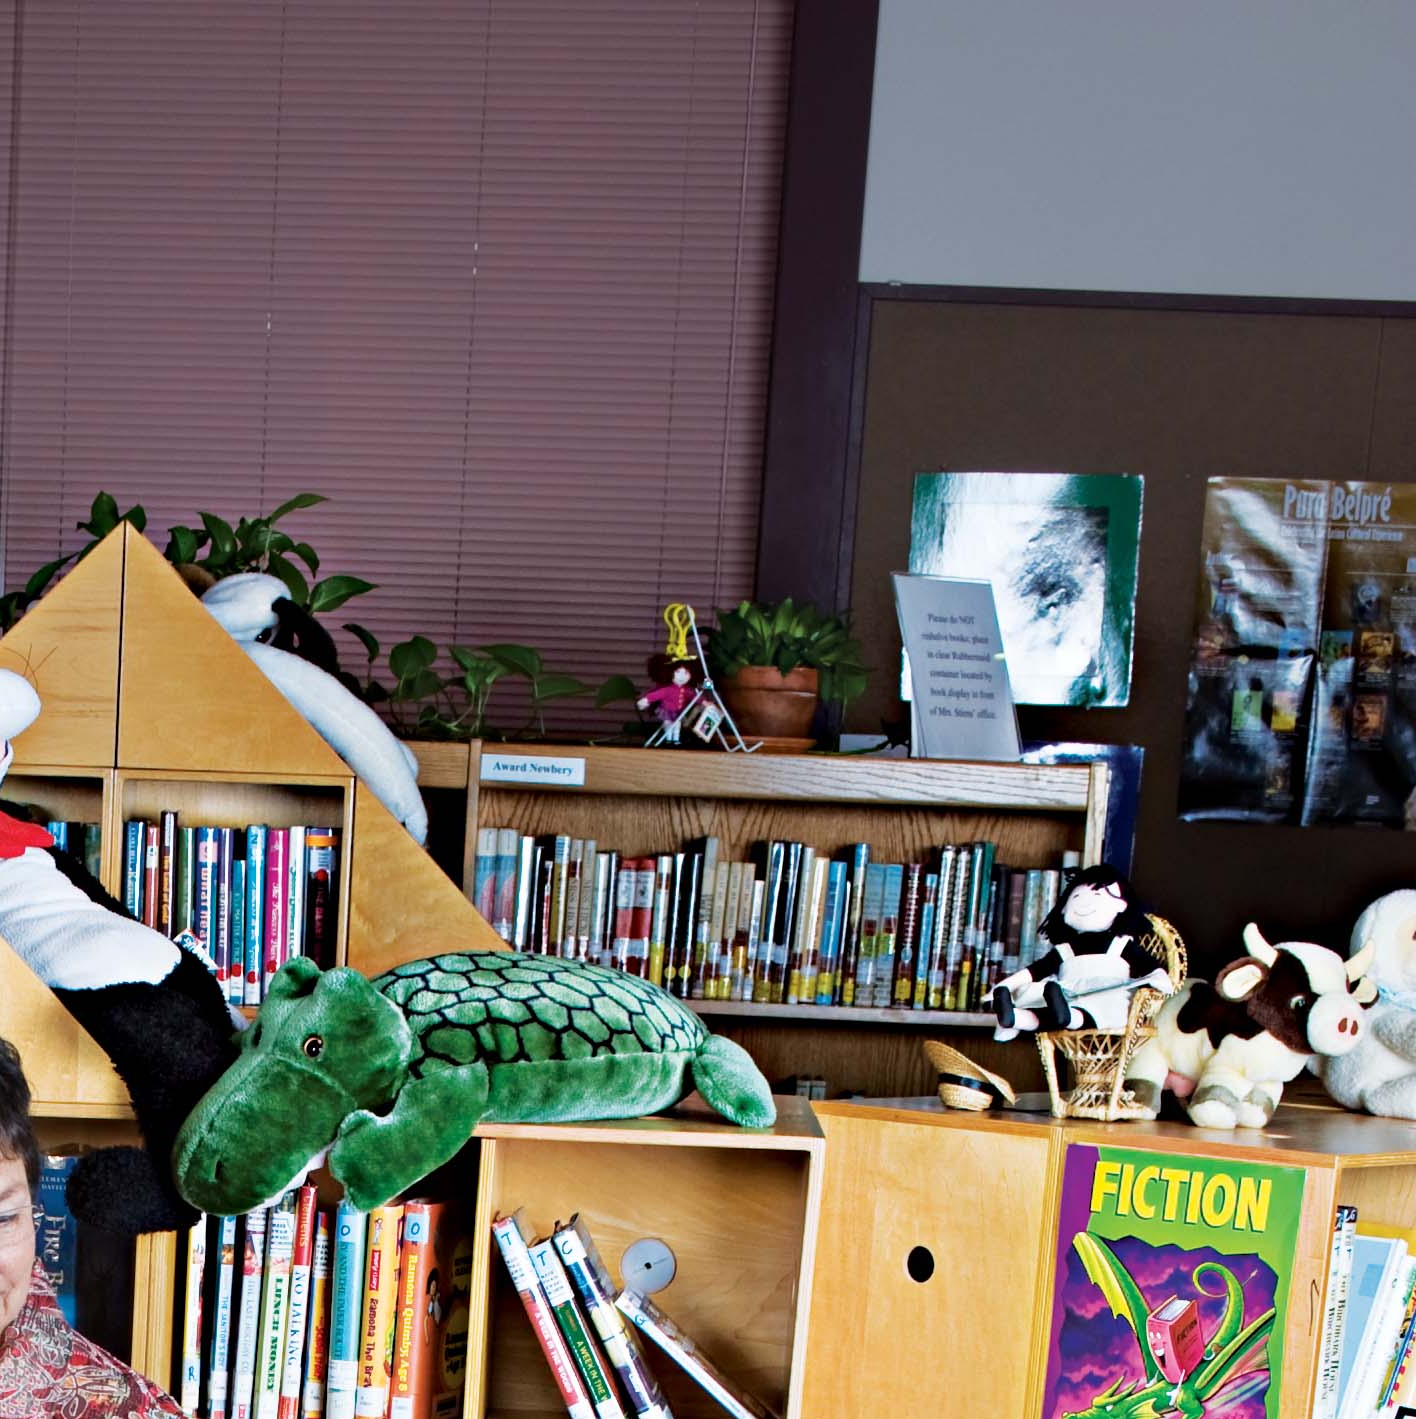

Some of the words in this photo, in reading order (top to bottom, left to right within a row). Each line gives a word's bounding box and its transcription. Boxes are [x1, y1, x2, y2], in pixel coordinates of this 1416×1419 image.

[1284, 484, 1326, 519] Pura
[1332, 485, 1393, 526] Belpré
[492, 761, 527, 772] Award
[529, 763, 573, 776] Newbery
[1090, 1160, 1273, 1232] FICTION
[500, 1232, 513, 1246] T
[536, 1250, 548, 1266] T
[295, 1272, 307, 1295] NO
[403, 1254, 418, 1305] Ramona
[272, 1278, 284, 1332] LUNCH
[368, 1299, 379, 1337] Ramona
[287, 1299, 303, 1367] TALKING
[266, 1335, 278, 1391] MONEY
[537, 1318, 549, 1339] WEEK
[549, 1348, 562, 1366] THE
[558, 1367, 573, 1393] WOODS
[579, 1348, 593, 1370] WEEK
[397, 1361, 409, 1382] Age
[589, 1367, 598, 1378] IN
[593, 1378, 605, 1395] THE
